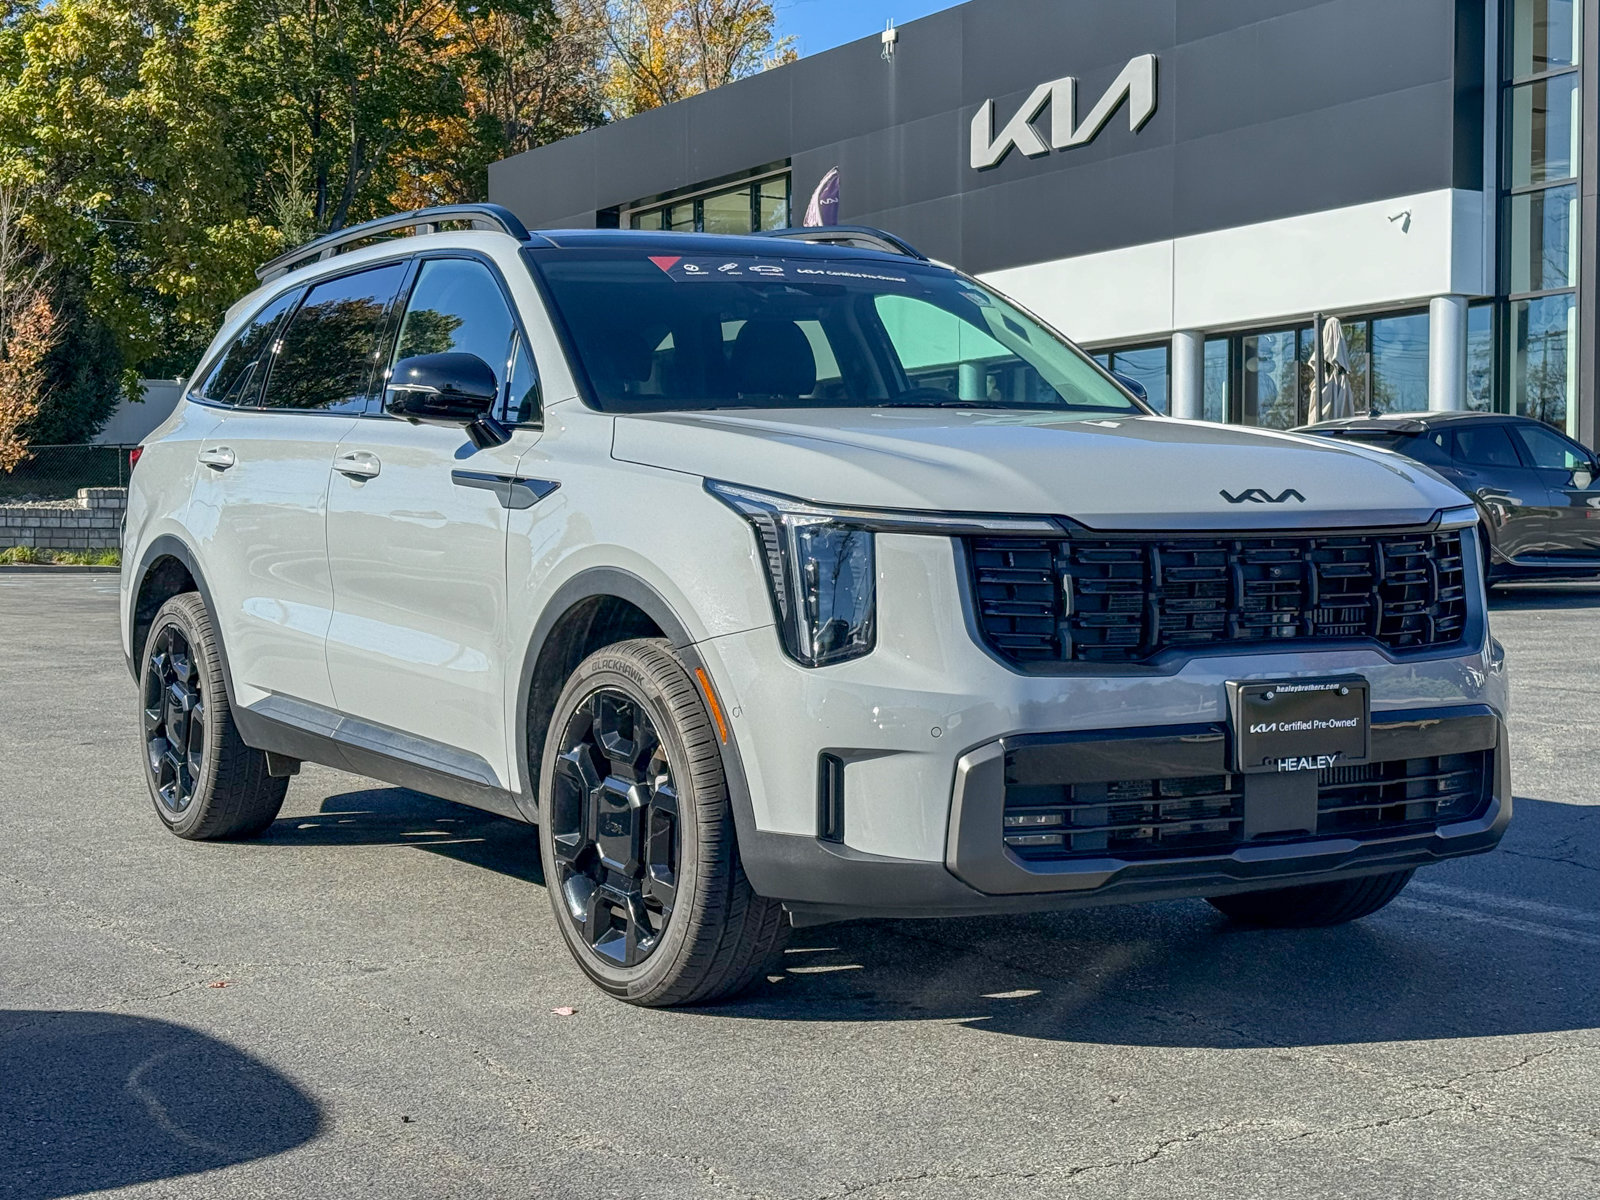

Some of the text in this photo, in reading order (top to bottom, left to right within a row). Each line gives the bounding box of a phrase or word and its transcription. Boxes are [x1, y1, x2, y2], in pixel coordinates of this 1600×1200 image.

[970, 53, 1158, 171] KIA
[1219, 488, 1307, 504] KIA
[591, 659, 645, 686] BLACKHAWK
[1275, 683, 1340, 693] healeybrothers.com
[1249, 722, 1277, 734] KIA
[1278, 720, 1312, 732] Certified
[1277, 754, 1337, 772] HEALEY
